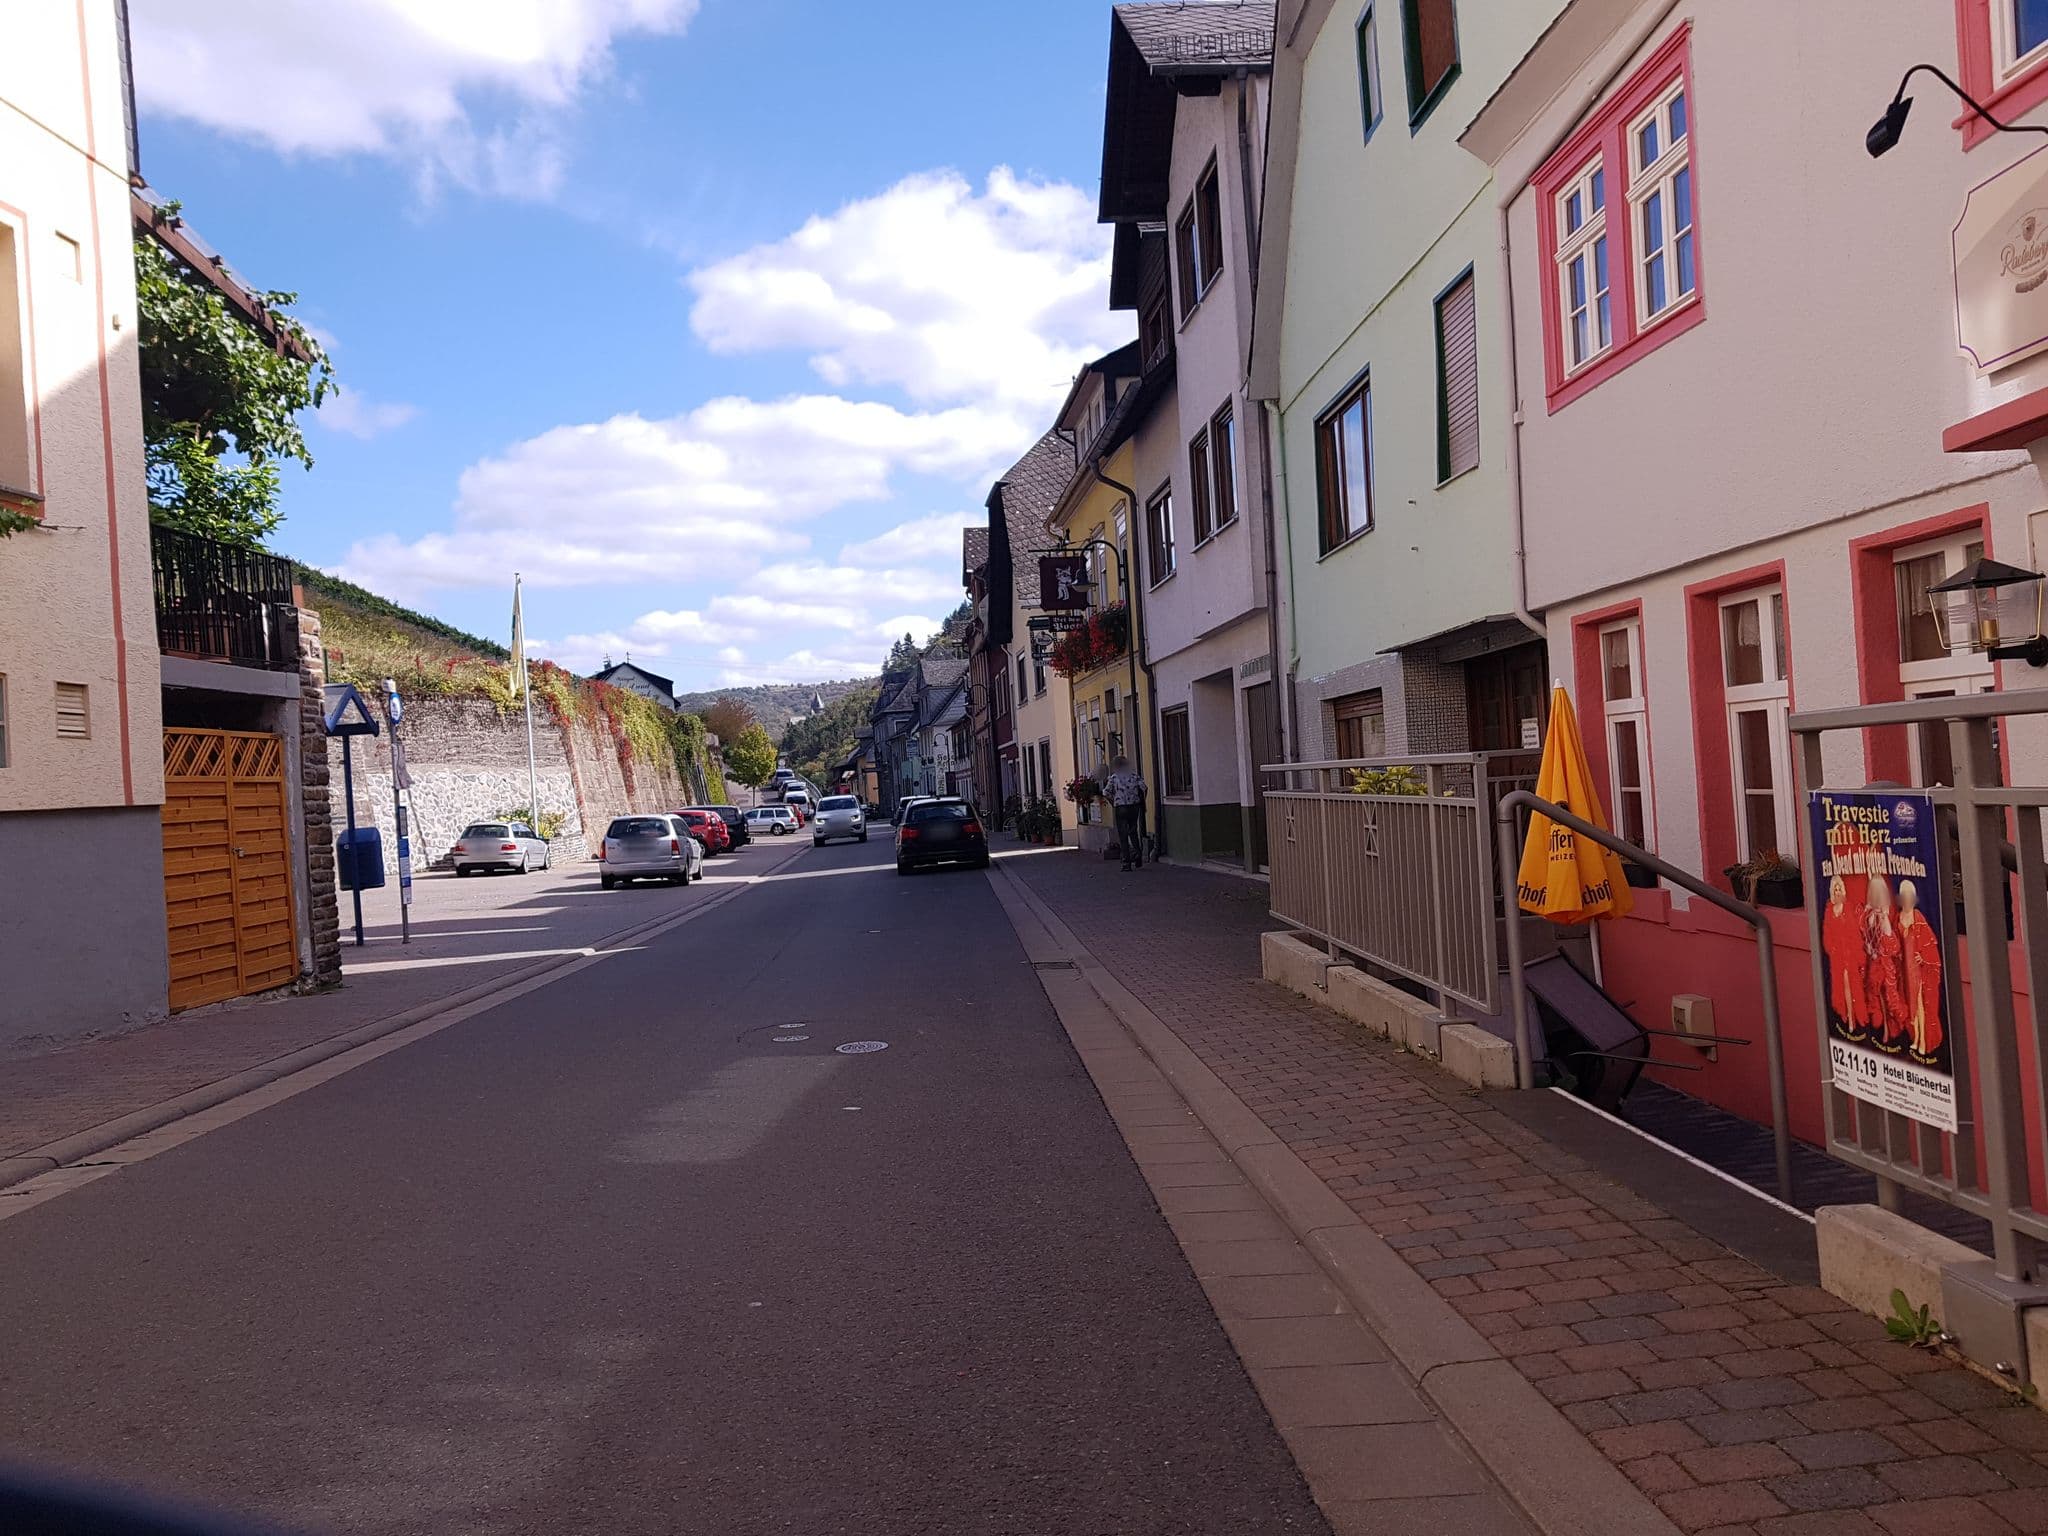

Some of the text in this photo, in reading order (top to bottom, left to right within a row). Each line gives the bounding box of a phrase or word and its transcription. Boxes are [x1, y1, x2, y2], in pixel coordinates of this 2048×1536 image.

[1822, 796, 1890, 823] Travestie
[1825, 825, 1855, 846] mit
[1858, 823, 1891, 844] Herz
[1822, 846, 1927, 880] Ein Abend mit guten Freunden
[1833, 1045, 1877, 1078] 02.11.19
[1882, 1063, 1904, 1080] Hotel
[1906, 1070, 1951, 1096] Blüchertal
